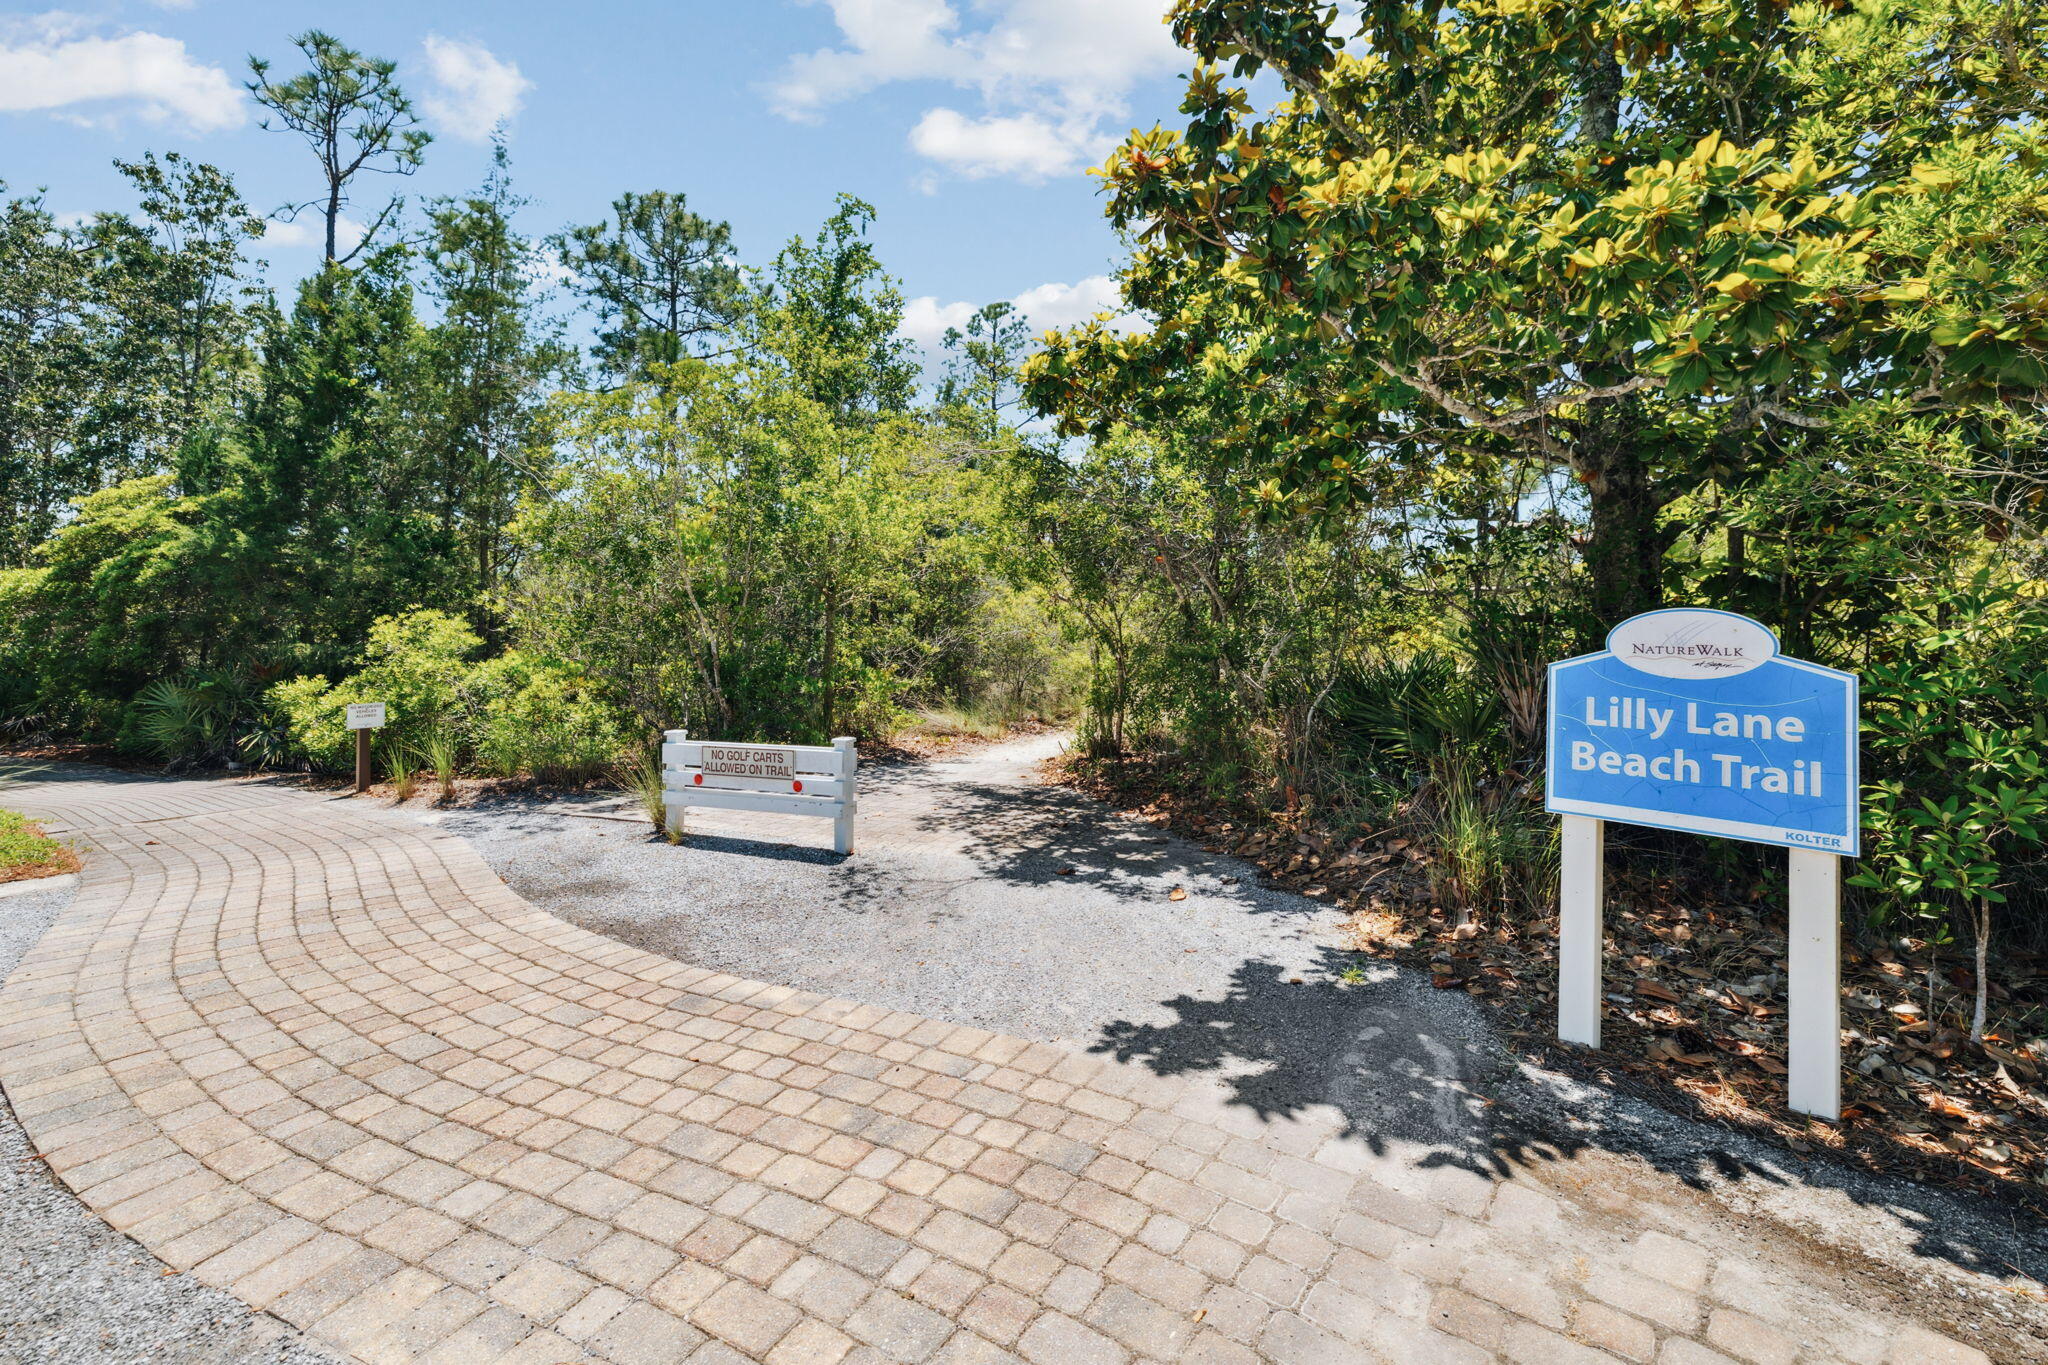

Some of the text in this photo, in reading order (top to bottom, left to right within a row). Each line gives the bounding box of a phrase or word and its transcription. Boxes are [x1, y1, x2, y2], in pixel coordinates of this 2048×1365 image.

[1585, 696, 1805, 742] Lilly Lane
[711, 750, 784, 763] NO GOLF CARTS
[704, 762, 791, 776] ALLOWED ON TRAIL
[1571, 740, 1821, 797] Beach Trail
[1785, 832, 1841, 847] KOLTER
